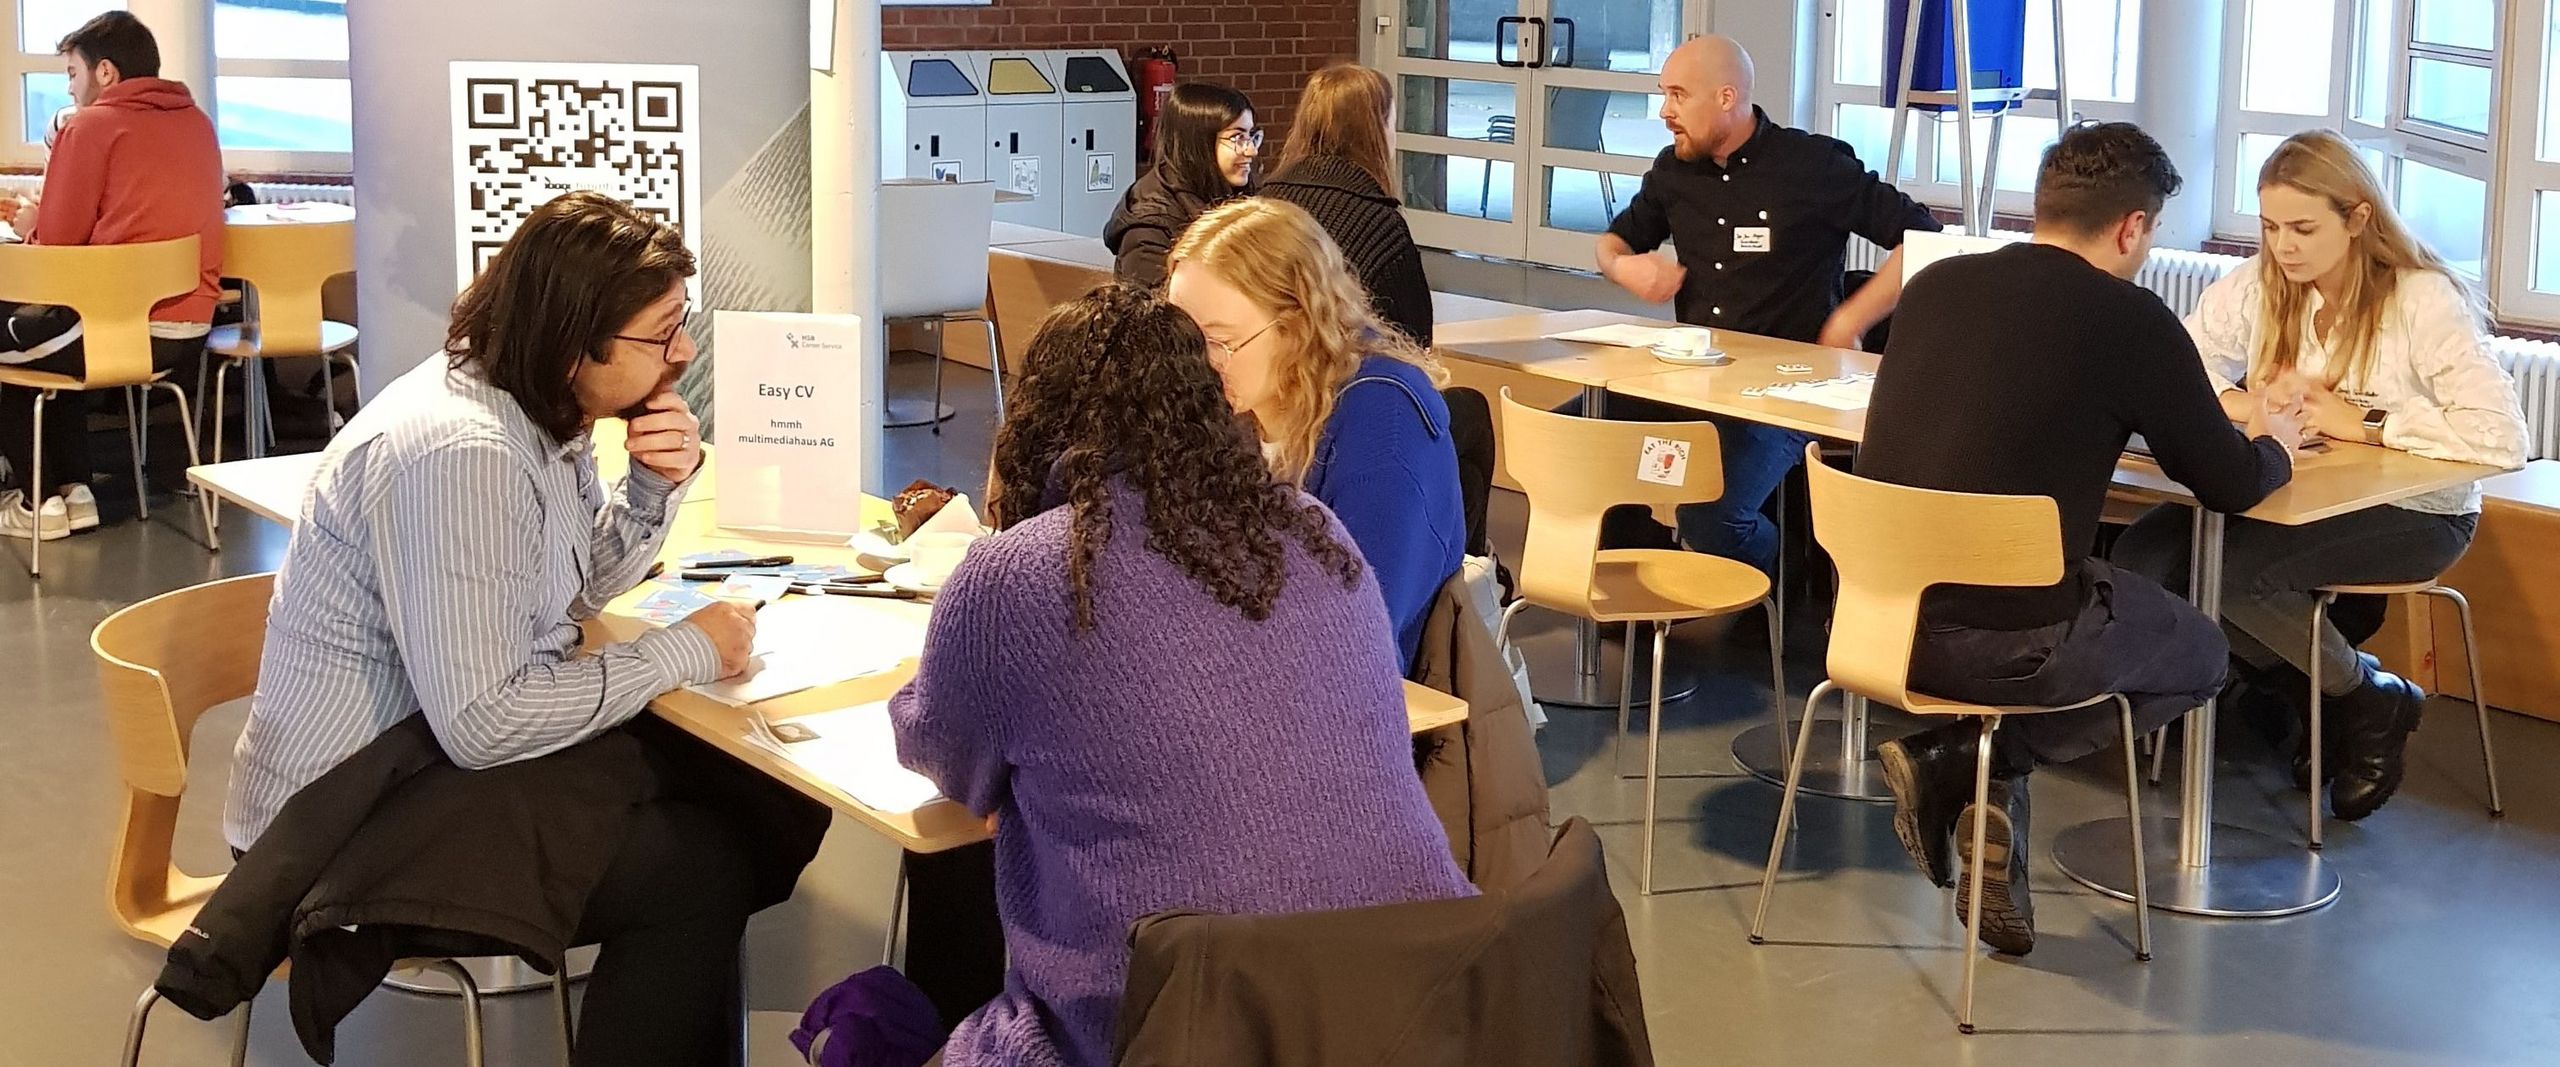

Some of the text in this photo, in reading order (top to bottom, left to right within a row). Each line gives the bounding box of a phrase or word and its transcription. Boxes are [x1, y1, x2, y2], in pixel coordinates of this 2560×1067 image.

[758, 383, 815, 400] Easy CV
[770, 419, 802, 429] hmmh
[738, 434, 835, 447] multimediahaus AG
